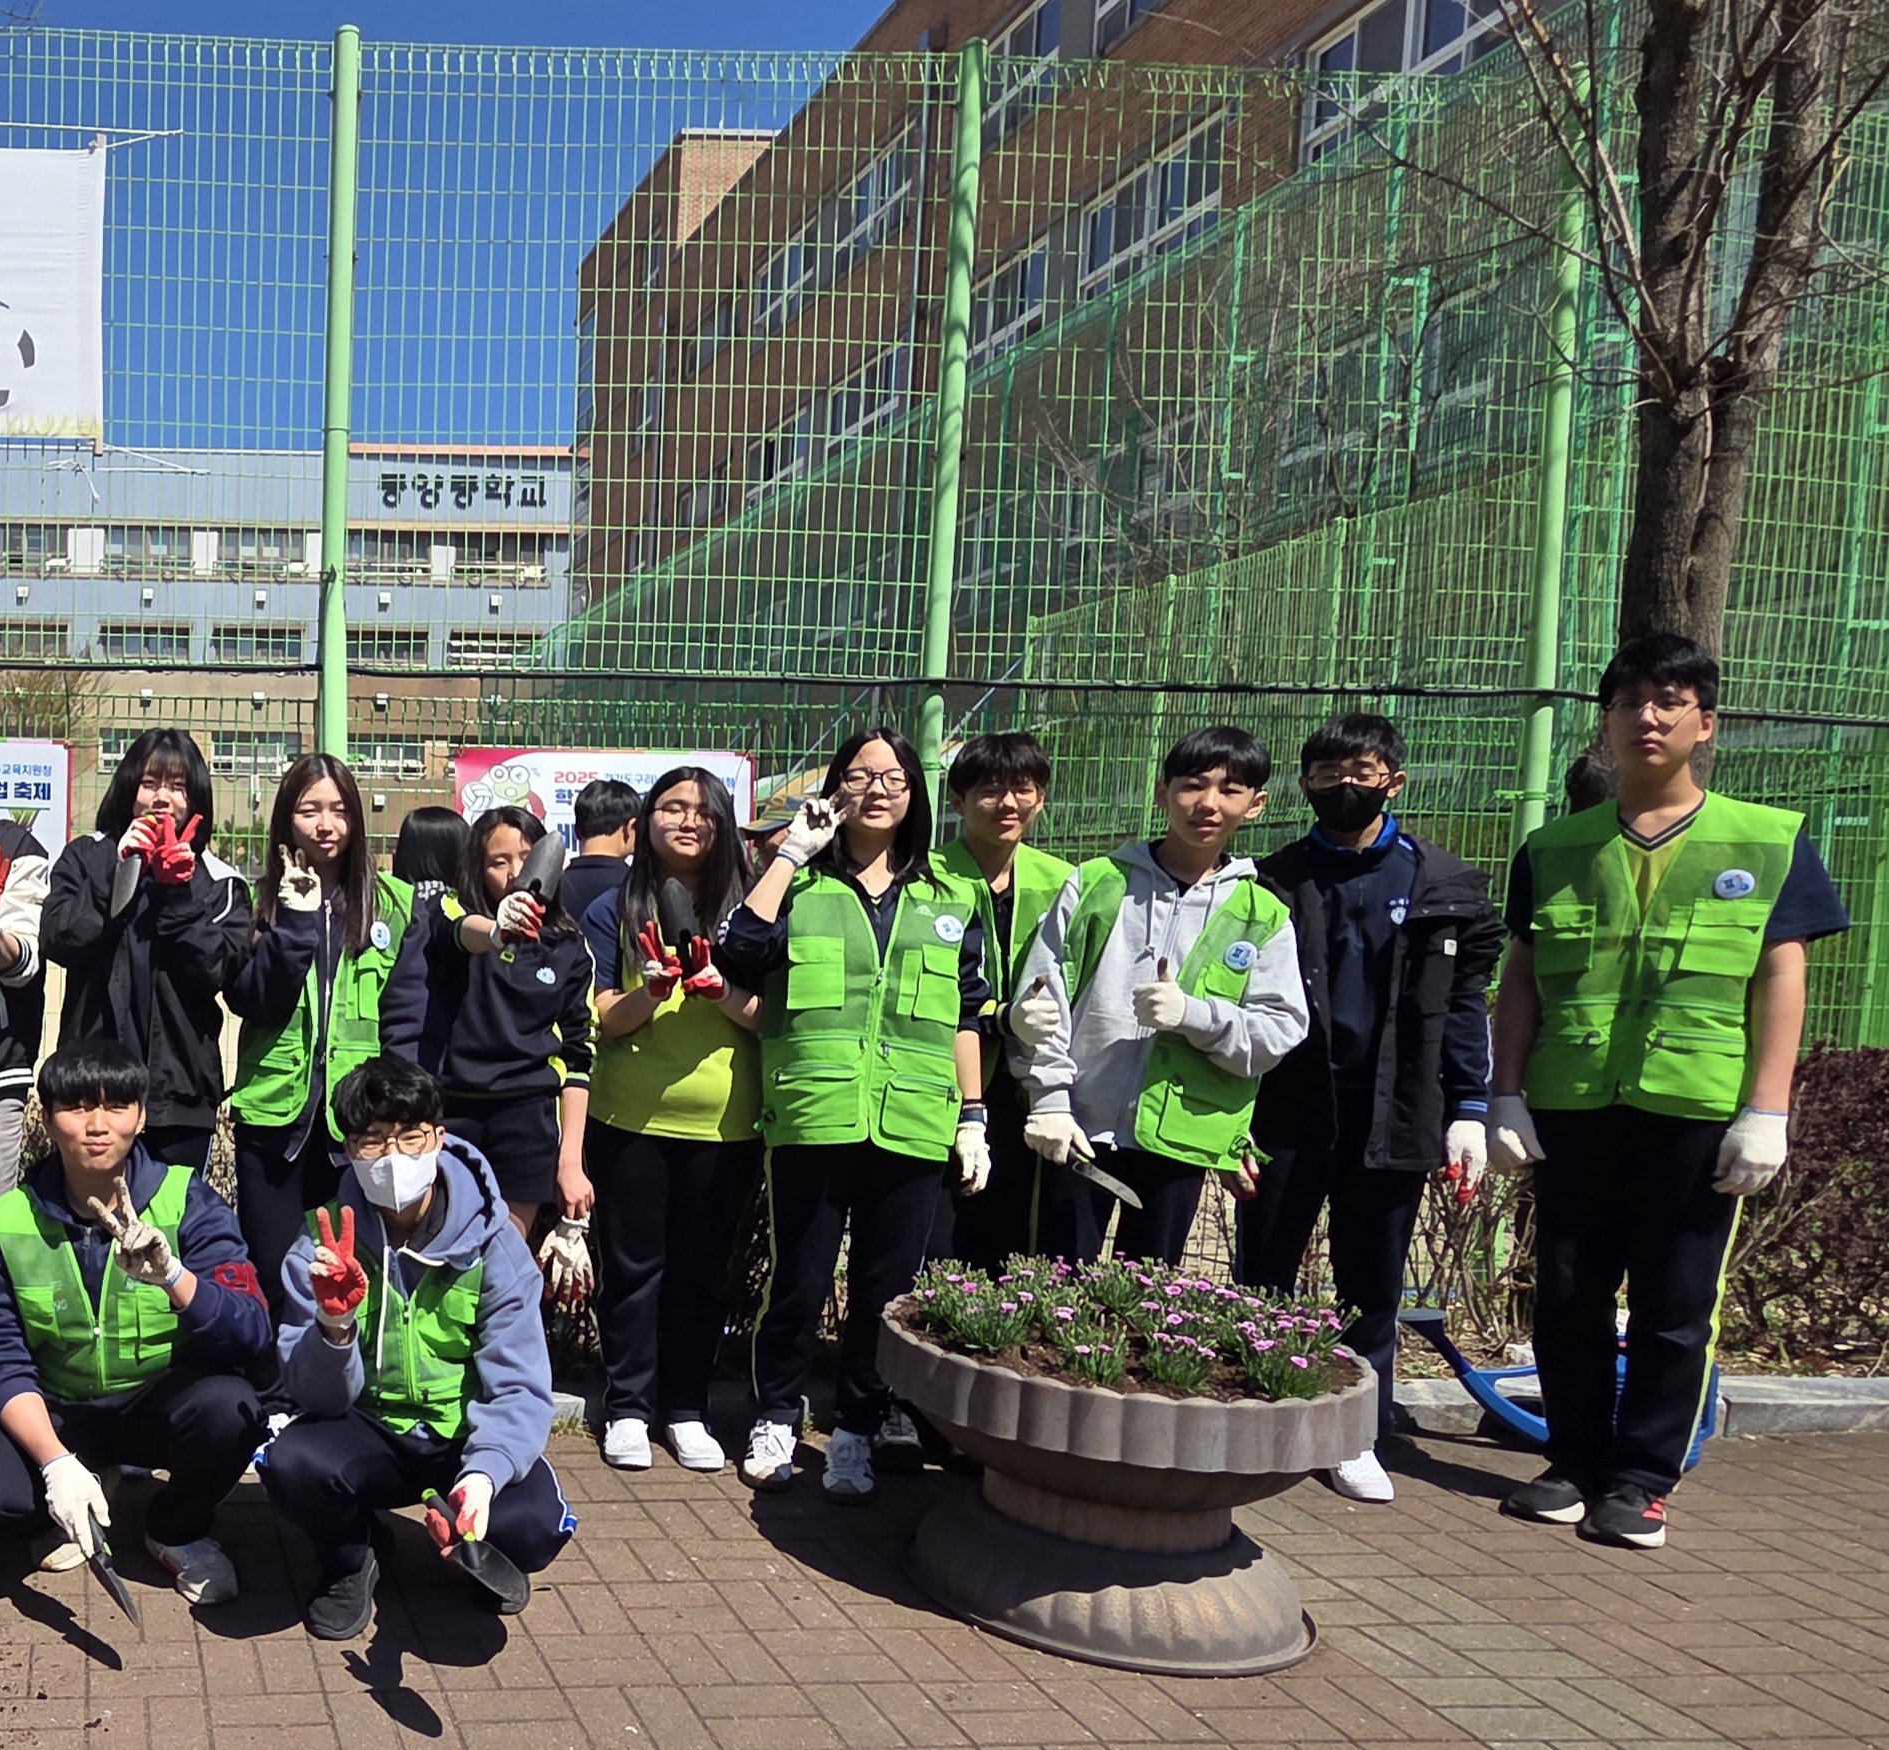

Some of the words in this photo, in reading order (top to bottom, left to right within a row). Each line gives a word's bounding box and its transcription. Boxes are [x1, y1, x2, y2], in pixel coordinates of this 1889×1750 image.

[378, 473, 547, 510] 동양중학교
[553, 771, 599, 785] 2025
[13, 781, 52, 802] 축제
